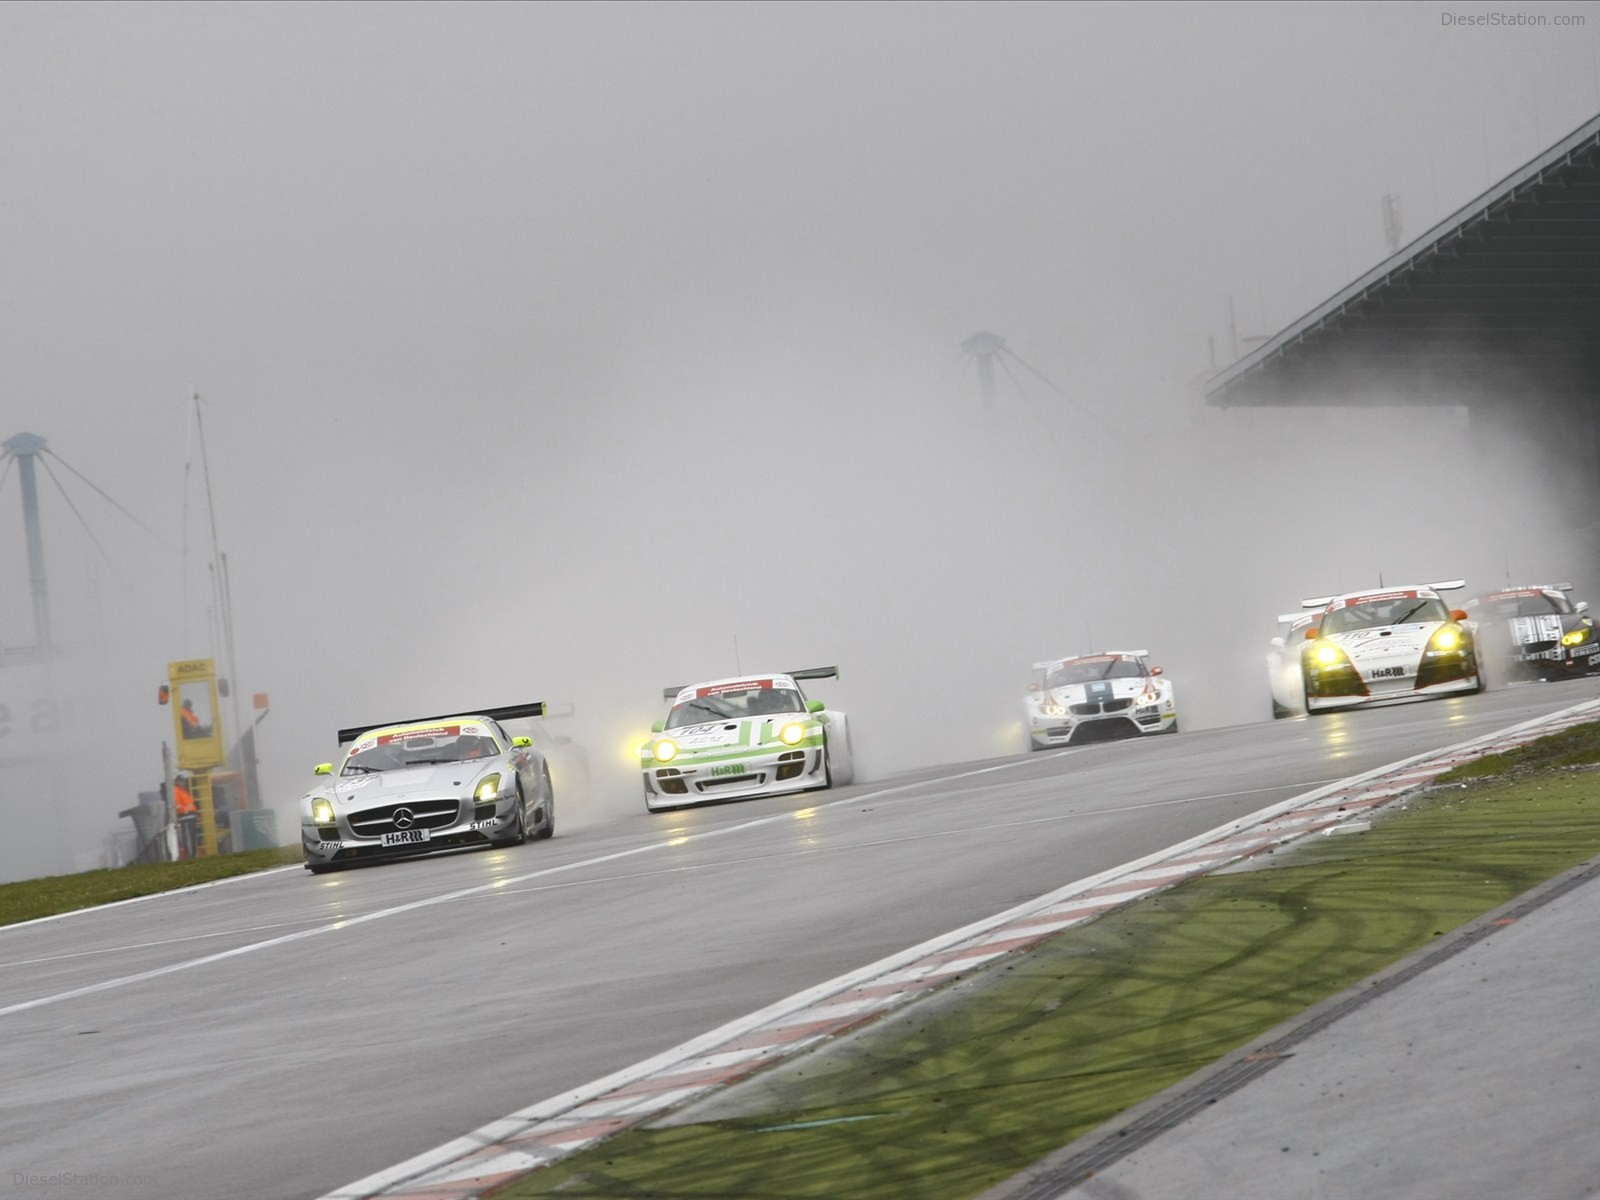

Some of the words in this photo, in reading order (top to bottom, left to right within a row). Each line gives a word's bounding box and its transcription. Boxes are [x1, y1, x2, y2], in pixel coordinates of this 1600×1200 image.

[177, 662, 206, 673] ADAC
[469, 819, 498, 832] STIHL
[385, 831, 410, 846] H&R
[319, 840, 345, 850] STIHL
